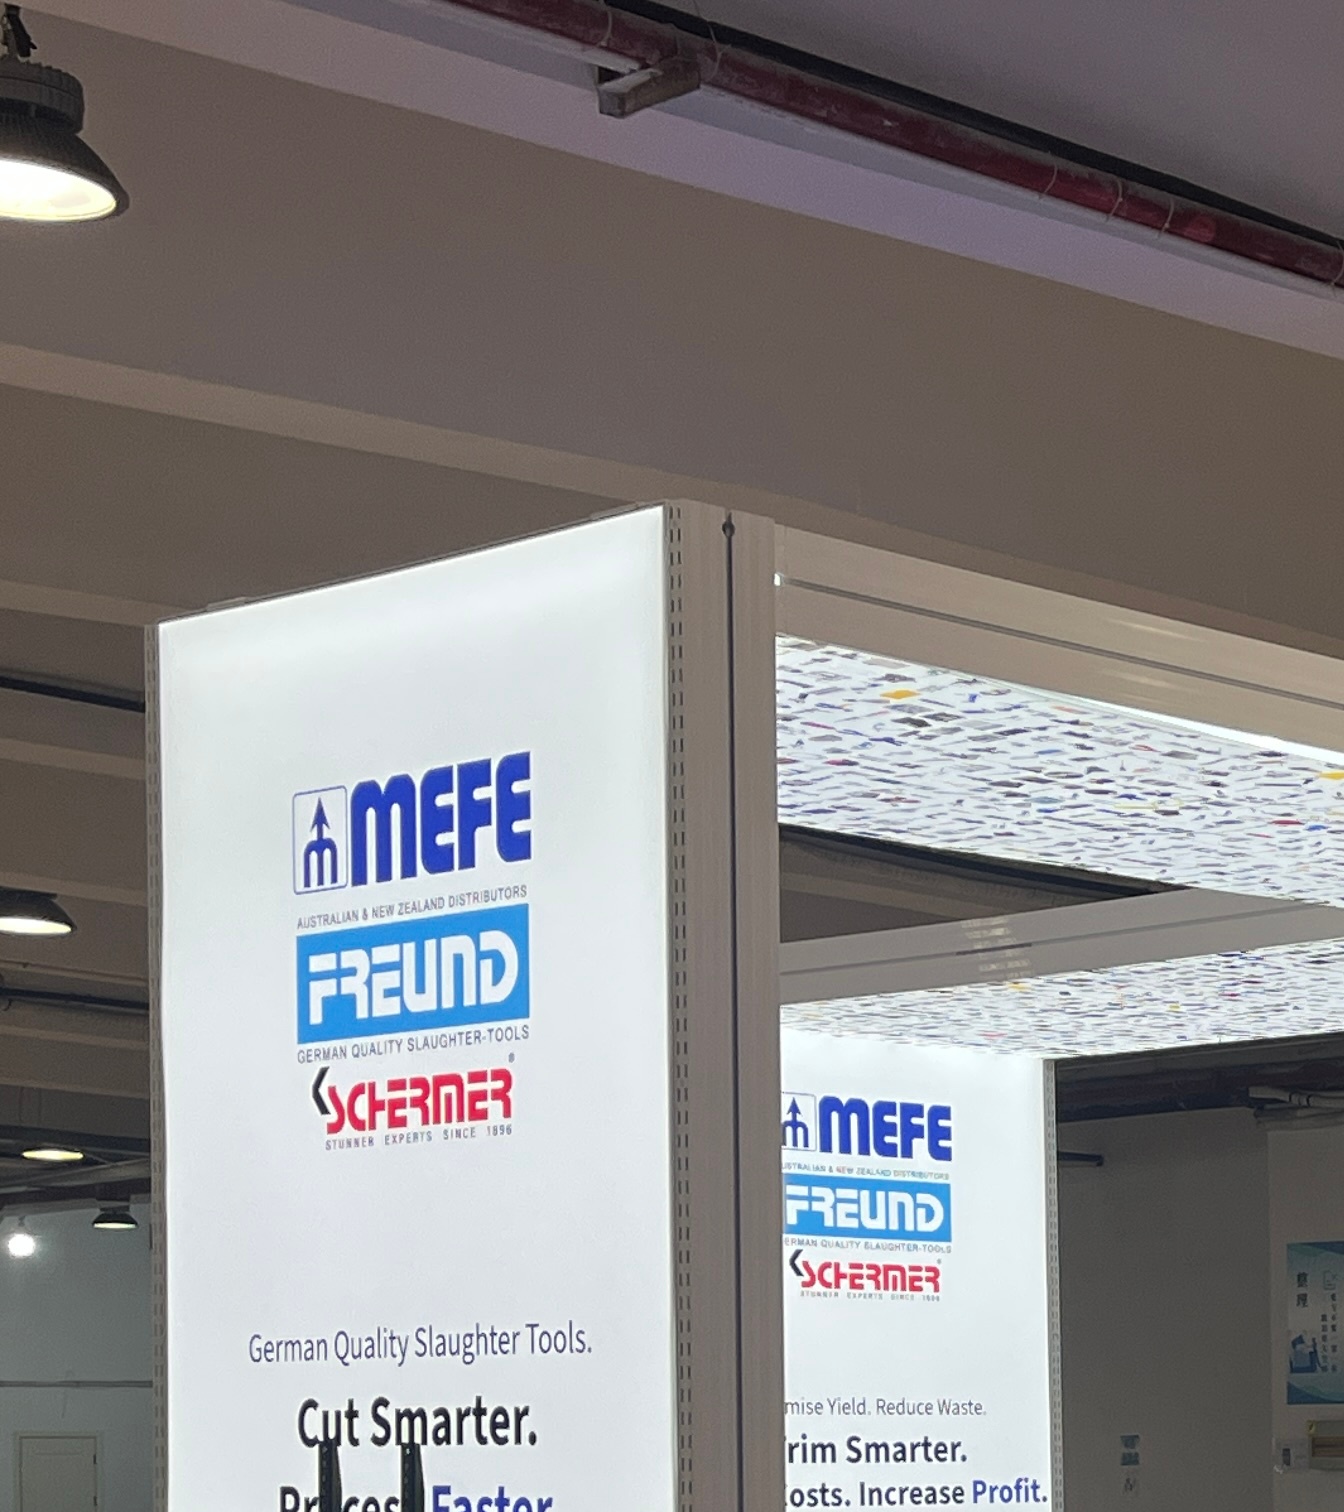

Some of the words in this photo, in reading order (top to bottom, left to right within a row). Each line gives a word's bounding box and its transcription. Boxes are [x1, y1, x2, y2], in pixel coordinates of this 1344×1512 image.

[351, 751, 531, 887] MEFE
[297, 908, 359, 930] AUSTRALIAN
[362, 907, 369, 922] &
[372, 901, 394, 920] NEW
[397, 896, 445, 917] ZEALAND
[448, 885, 528, 909] DISTRIBUTORS
[309, 930, 519, 1025] FREUND
[297, 1045, 347, 1064] GERMAN
[352, 1038, 403, 1060] QUALITY
[407, 1025, 530, 1054] SLAUGHTER-TOOLS
[326, 1068, 514, 1135] SCHERMER
[443, 1128, 477, 1142] SINCE
[818, 1096, 952, 1162] MEFE
[783, 1162, 826, 1172] USTRALIAN
[786, 1184, 944, 1232] FREUND
[784, 1239, 818, 1248] ERMAN
[820, 1239, 861, 1249] QUALITY
[801, 1260, 940, 1293] SCHERMER
[249, 1333, 328, 1364] German
[334, 1327, 409, 1367] Quality
[414, 1322, 520, 1365] Slaughter
[525, 1320, 593, 1355] Tools.
[298, 1397, 360, 1448] Cut
[370, 1395, 538, 1448] Smarter.
[785, 1398, 823, 1415] mise
[827, 1397, 871, 1415] Yield.
[876, 1397, 934, 1415] Reduce
[937, 1398, 986, 1416] Waste.
[785, 1433, 836, 1463] rim
[846, 1435, 967, 1464] Smarter.
[785, 1482, 850, 1507] osts.
[860, 1481, 964, 1506] Increase
[972, 1477, 1047, 1504] Profit.
